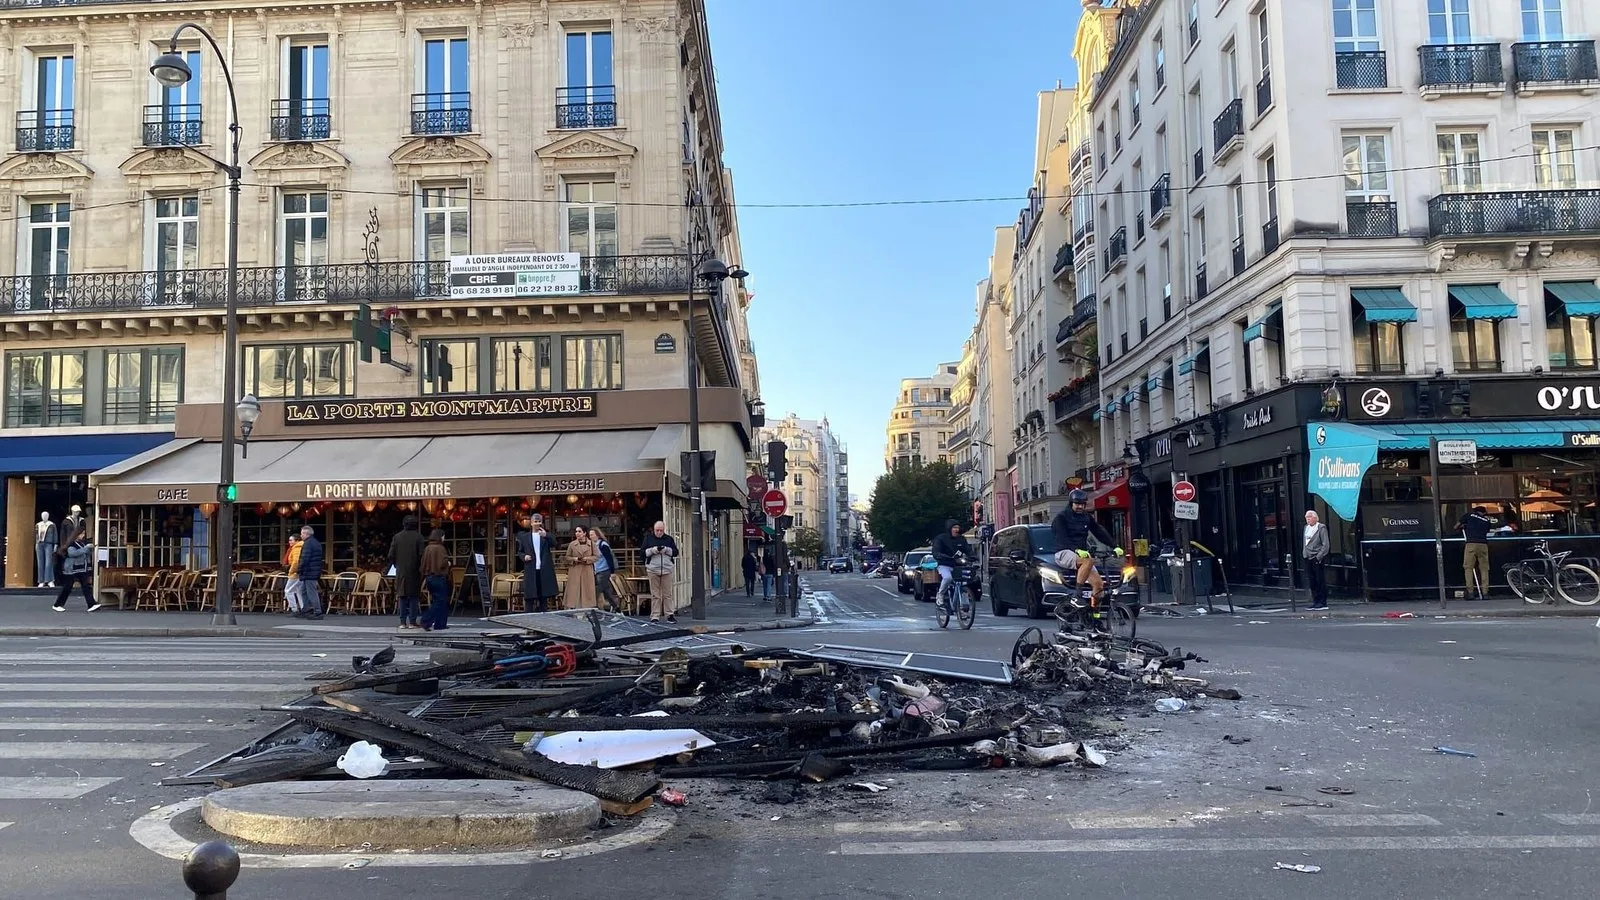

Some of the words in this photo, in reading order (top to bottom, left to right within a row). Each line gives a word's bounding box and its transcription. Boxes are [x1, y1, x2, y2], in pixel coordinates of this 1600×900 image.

[469, 275, 498, 284] CBRE
[528, 274, 556, 283] bnppre.fr
[288, 405, 318, 420] LA
[324, 402, 405, 420] PORTE
[410, 396, 592, 416] MONTMARTRE
[1243, 410, 1258, 430] Irish
[1259, 405, 1271, 426] Pub
[1318, 455, 1360, 478] O'Sullivans
[306, 484, 321, 498] LA
[325, 482, 363, 498] PORTE
[367, 482, 451, 497] MONTMARTRE
[534, 479, 604, 492] BRASSERIE
[157, 488, 188, 501] CAFE
